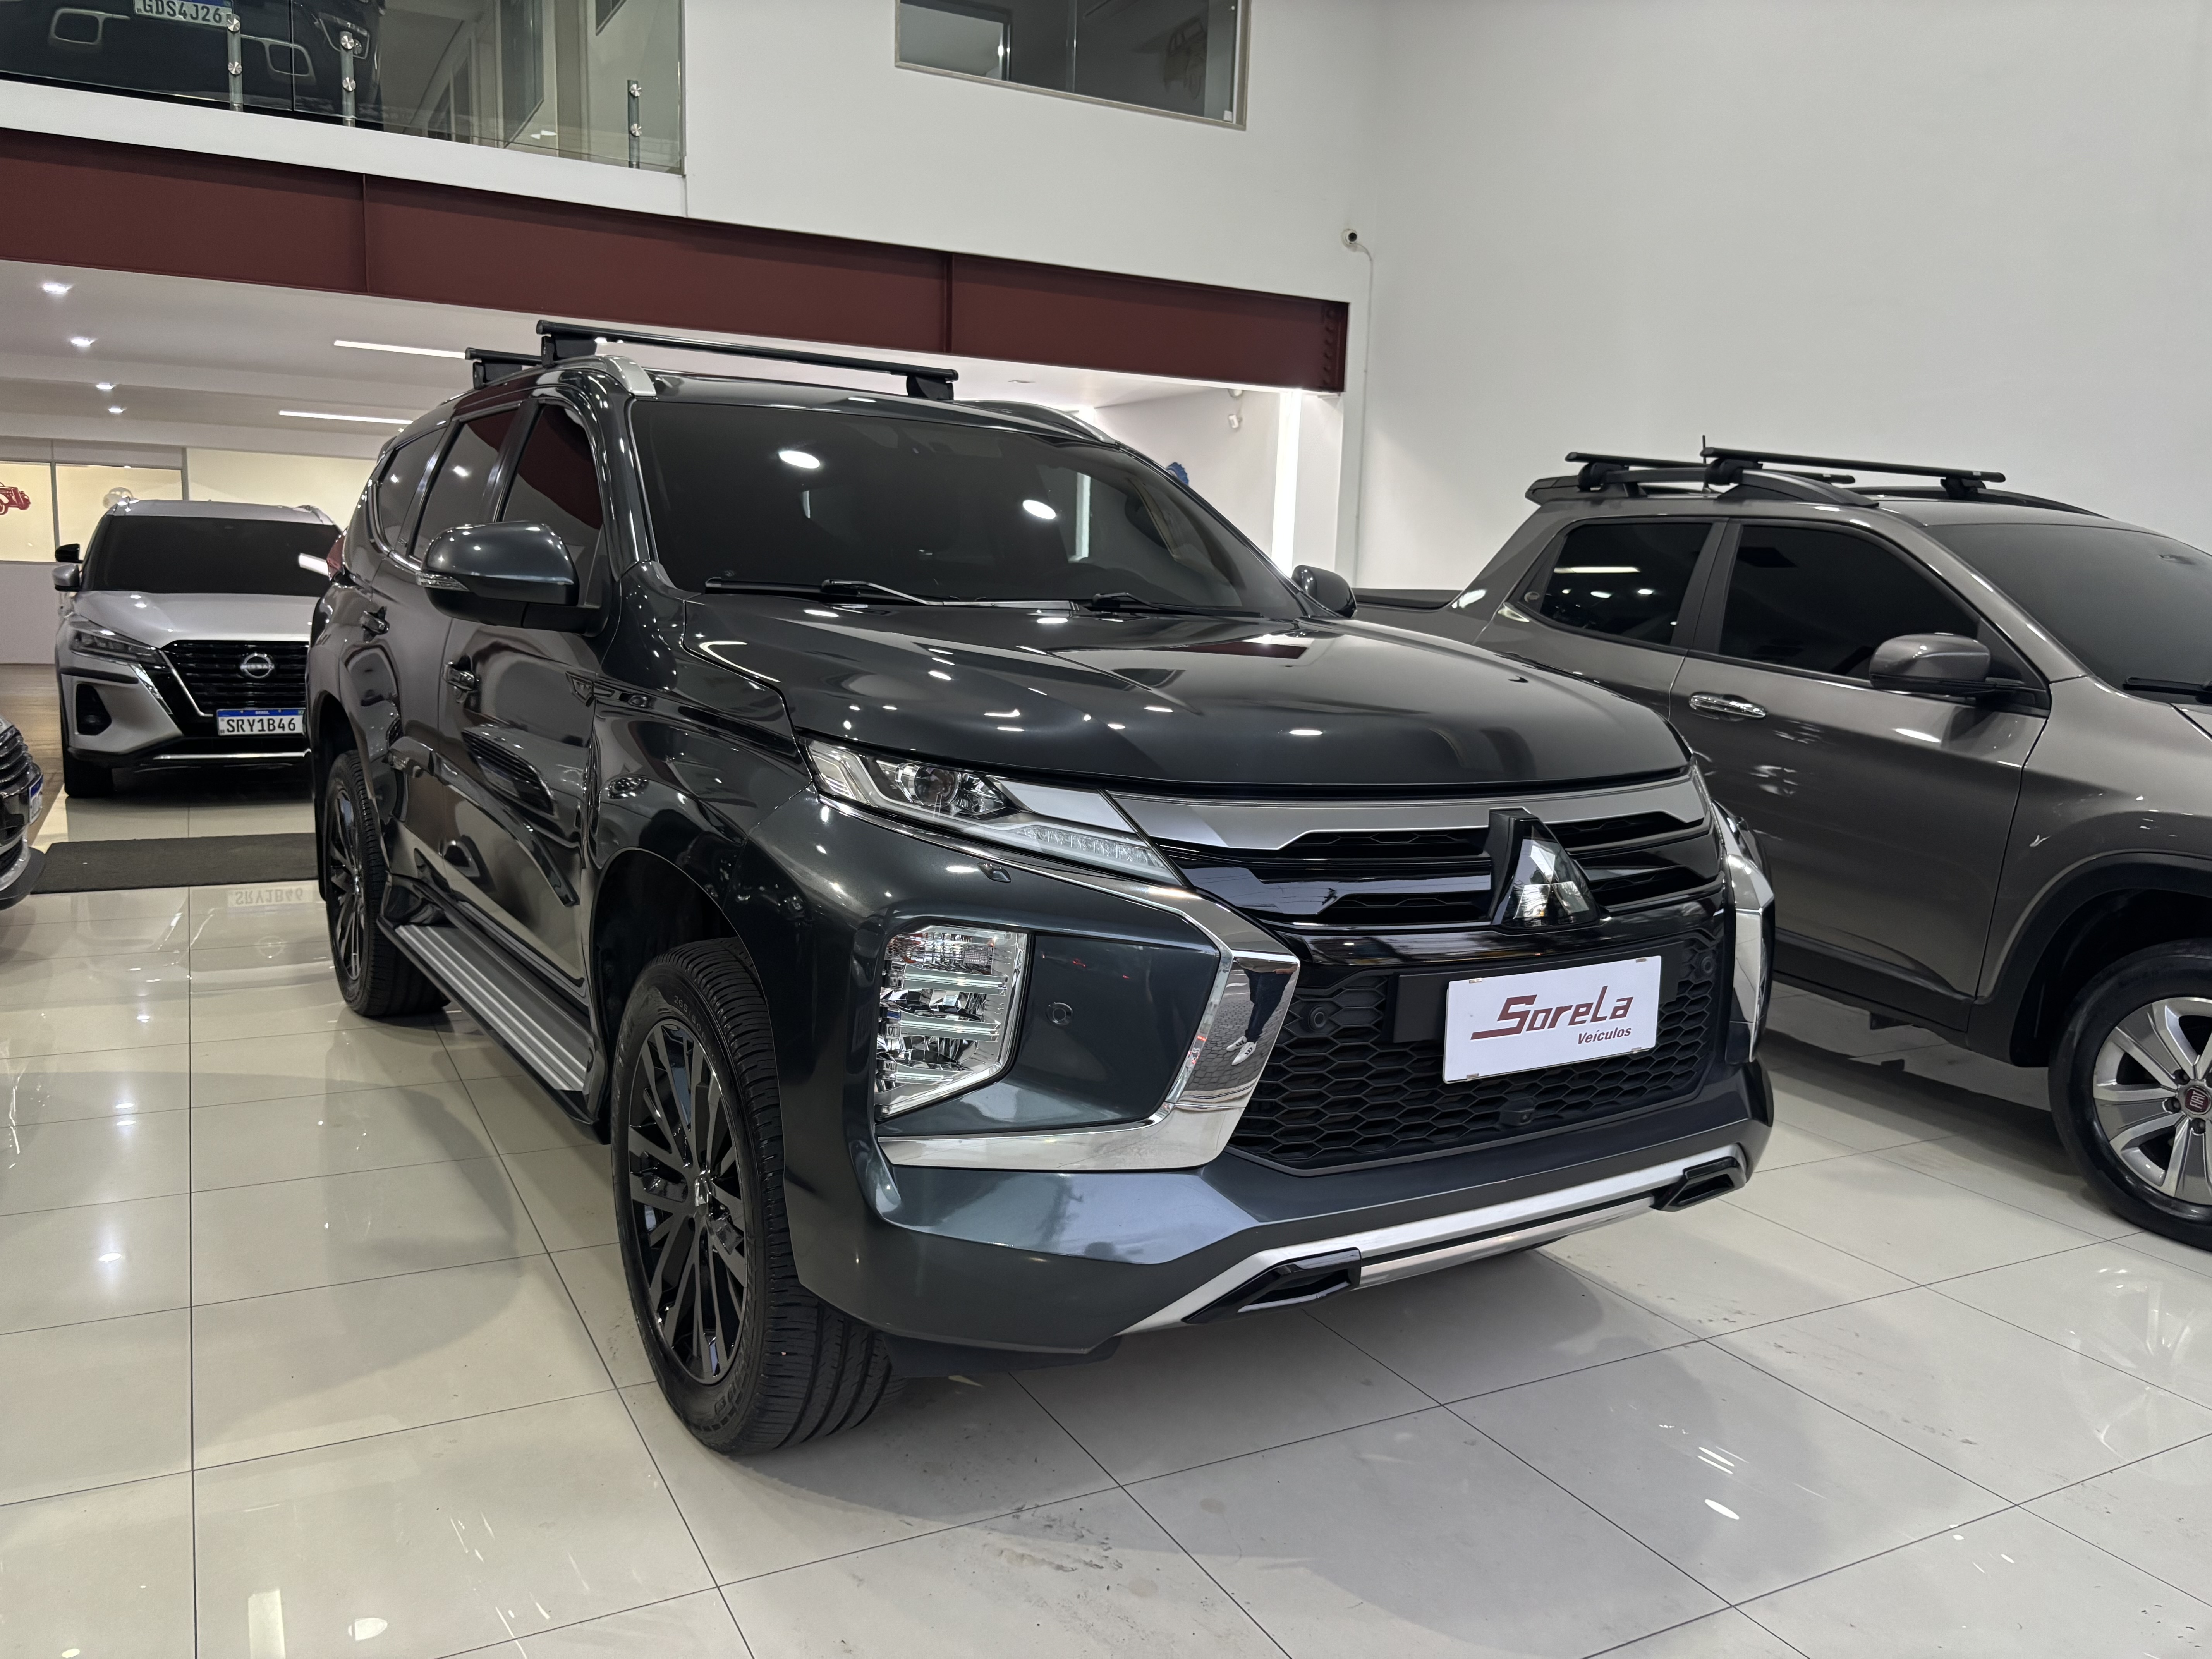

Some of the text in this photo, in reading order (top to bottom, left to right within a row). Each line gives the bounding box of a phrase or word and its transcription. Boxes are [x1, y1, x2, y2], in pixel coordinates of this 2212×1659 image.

[143, 0, 222, 23] GDS4J26
[227, 718, 296, 733] SRY1B46
[1578, 1027, 1632, 1045] Veículos
[2190, 1090, 2205, 1109] FIAT
